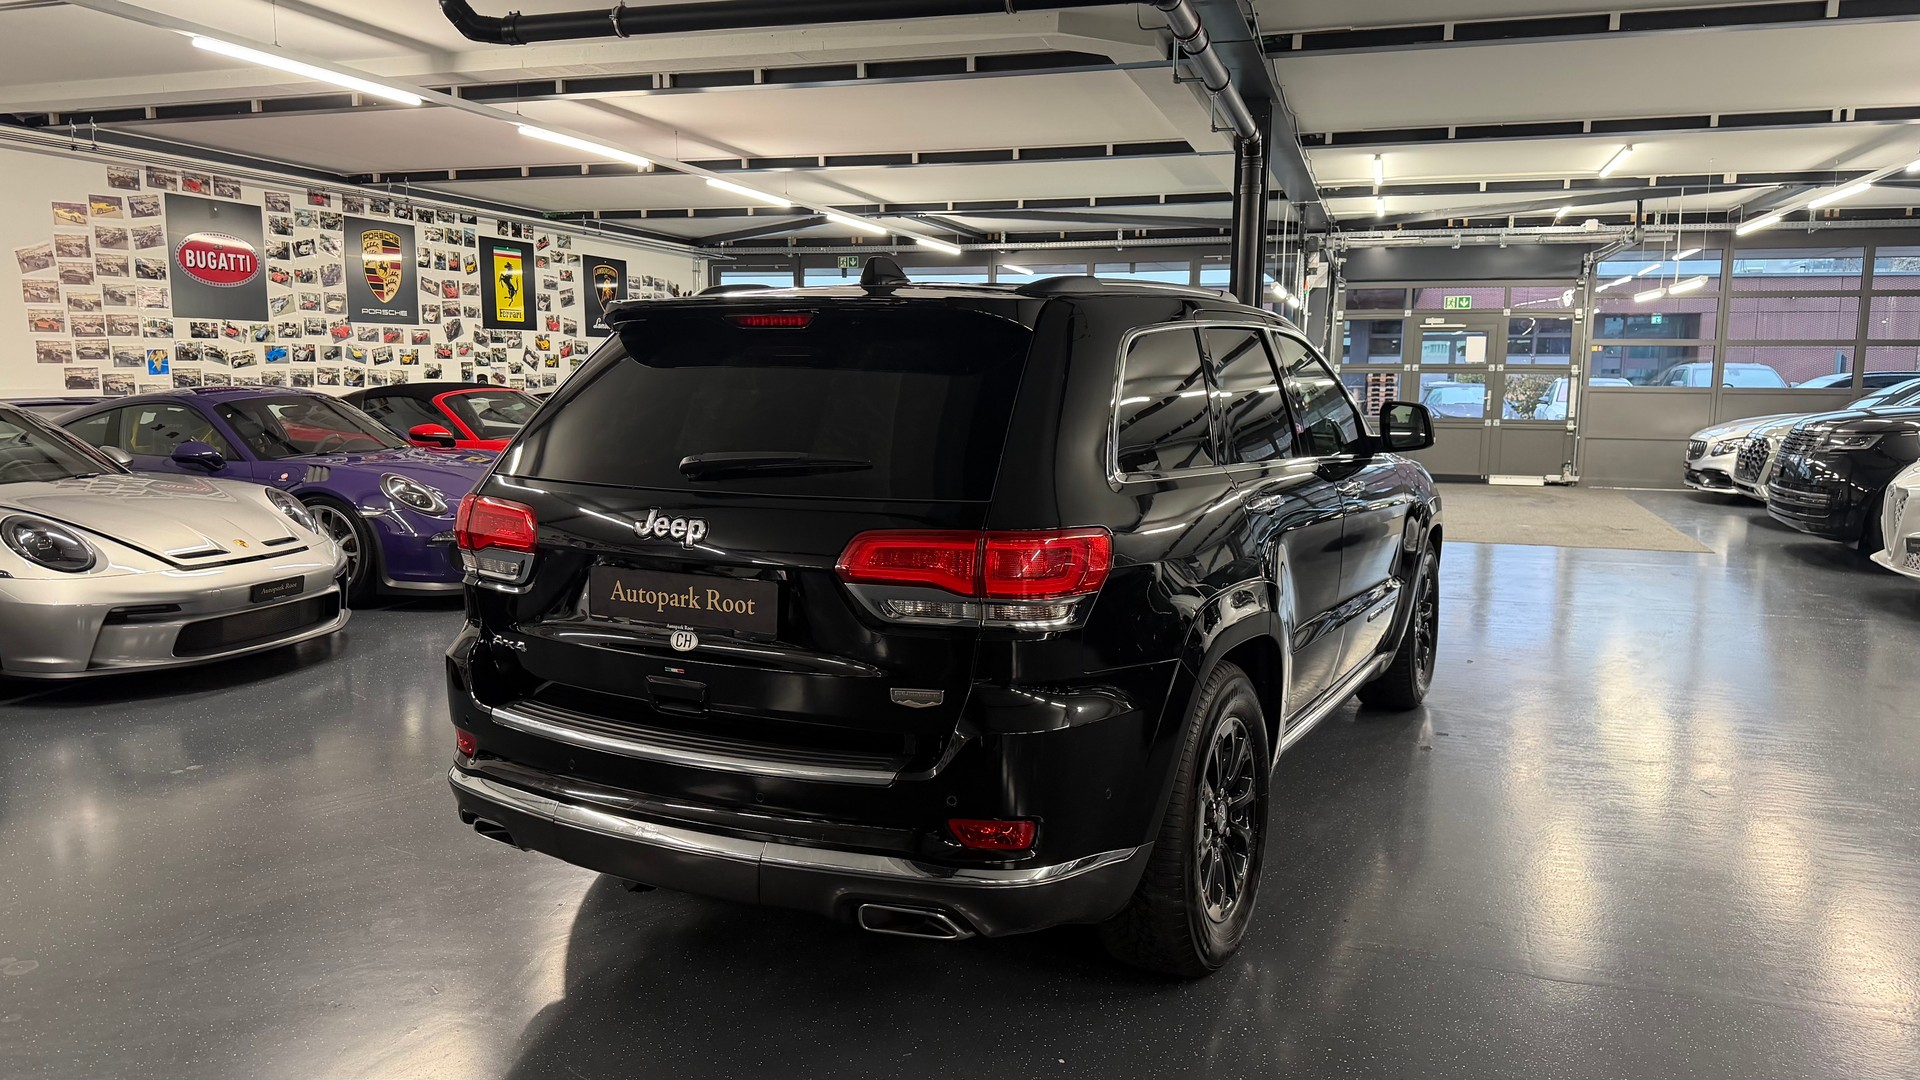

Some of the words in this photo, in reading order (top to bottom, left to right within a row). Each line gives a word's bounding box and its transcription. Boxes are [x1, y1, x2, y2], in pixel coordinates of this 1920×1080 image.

[363, 232, 400, 244] PORSCHE
[185, 249, 252, 272] BUGATTI
[361, 308, 408, 317] PORSCHE
[499, 308, 522, 319] Ferrari
[634, 508, 708, 547] Jeep
[610, 579, 701, 613] Autopark
[705, 588, 756, 615] Root
[676, 632, 692, 649] CH
